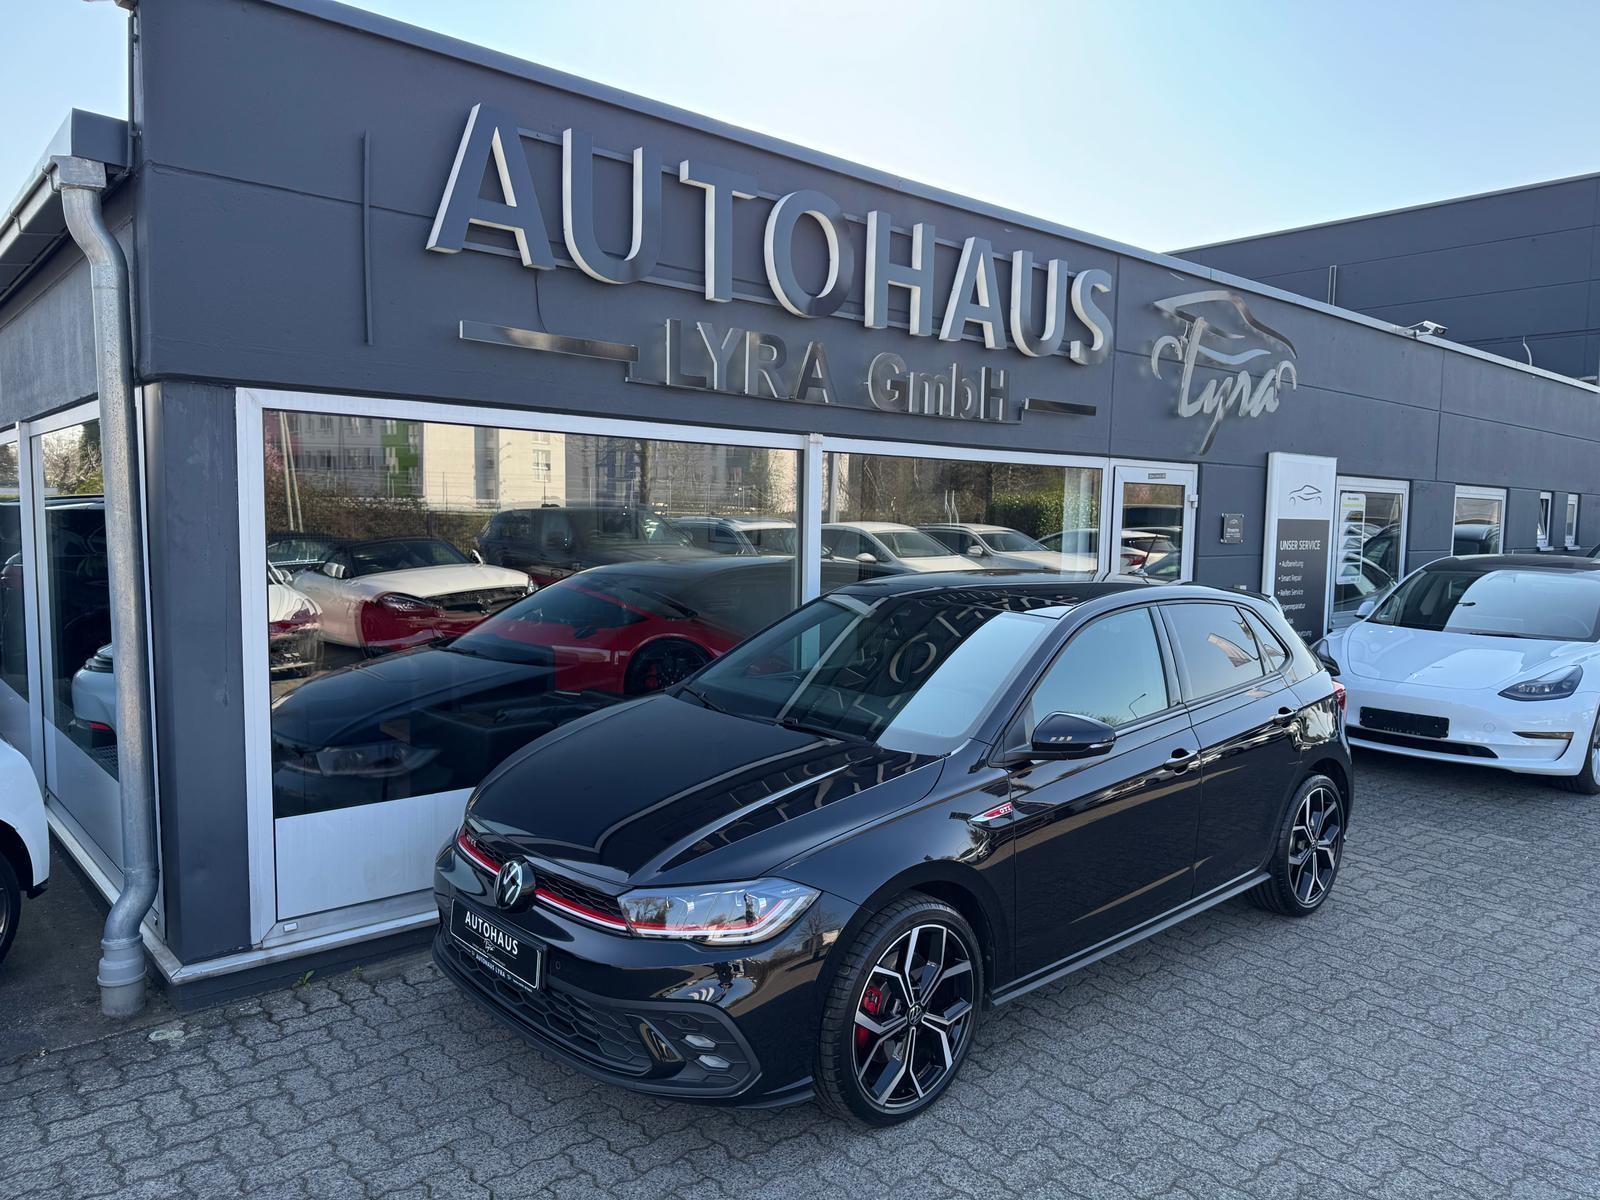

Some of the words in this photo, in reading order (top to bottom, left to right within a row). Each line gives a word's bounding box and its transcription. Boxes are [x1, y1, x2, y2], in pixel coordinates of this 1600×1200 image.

[425, 102, 1114, 366] AUTOHAUS
[665, 319, 838, 404] LYRA
[867, 352, 1009, 421] GmbH
[1280, 540, 1298, 550] UNSER
[1299, 540, 1321, 550] SERVICE
[1281, 560, 1304, 568] Aufbereitung
[1280, 574, 1291, 582] Smart
[1291, 574, 1303, 582] Repair
[465, 911, 518, 955] AUTOHAUS
[475, 953, 495, 971] AUTOHAUS
[495, 966, 506, 978] LYRA
